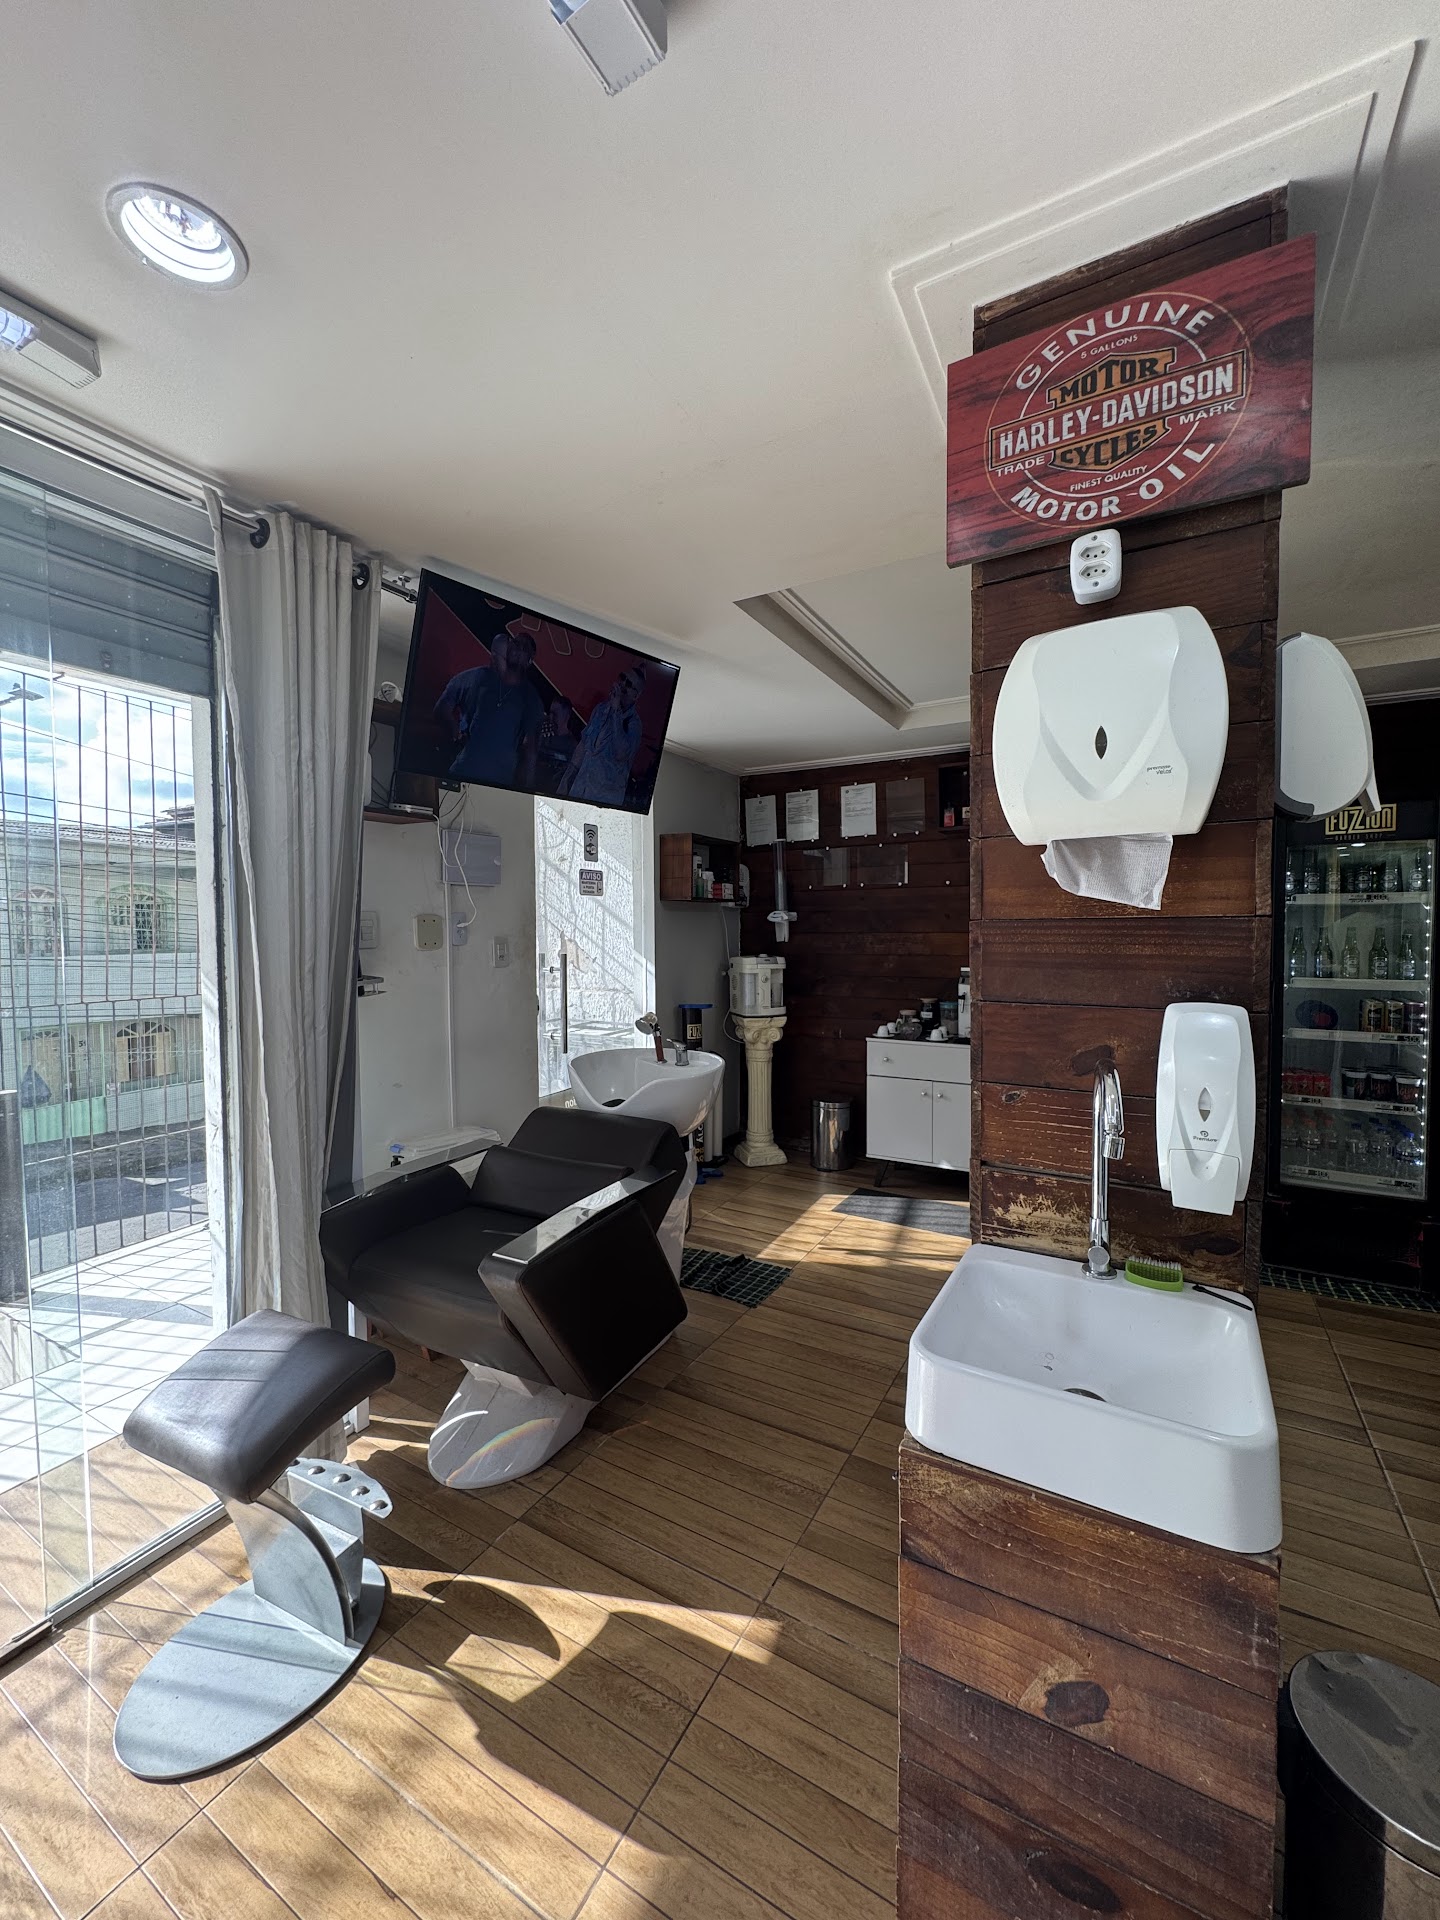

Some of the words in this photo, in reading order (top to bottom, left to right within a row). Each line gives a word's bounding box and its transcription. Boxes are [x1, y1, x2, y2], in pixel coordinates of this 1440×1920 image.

[1015, 300, 1215, 391] GENUINE
[1080, 351, 1087, 360] 5
[1089, 334, 1139, 357] GALLONS
[1058, 357, 1159, 405] MOTOR
[998, 363, 1235, 460] HARLEY-DAVIDSON
[995, 455, 1046, 478] TRADE
[1178, 401, 1236, 426] MARK
[1059, 424, 1158, 468] CYCLES
[1010, 485, 1122, 523] MOTOR
[1138, 441, 1216, 501] OIL
[1069, 477, 1103, 493] FINEST
[1104, 464, 1148, 484] QUALITY
[582, 872, 601, 880] AVISO
